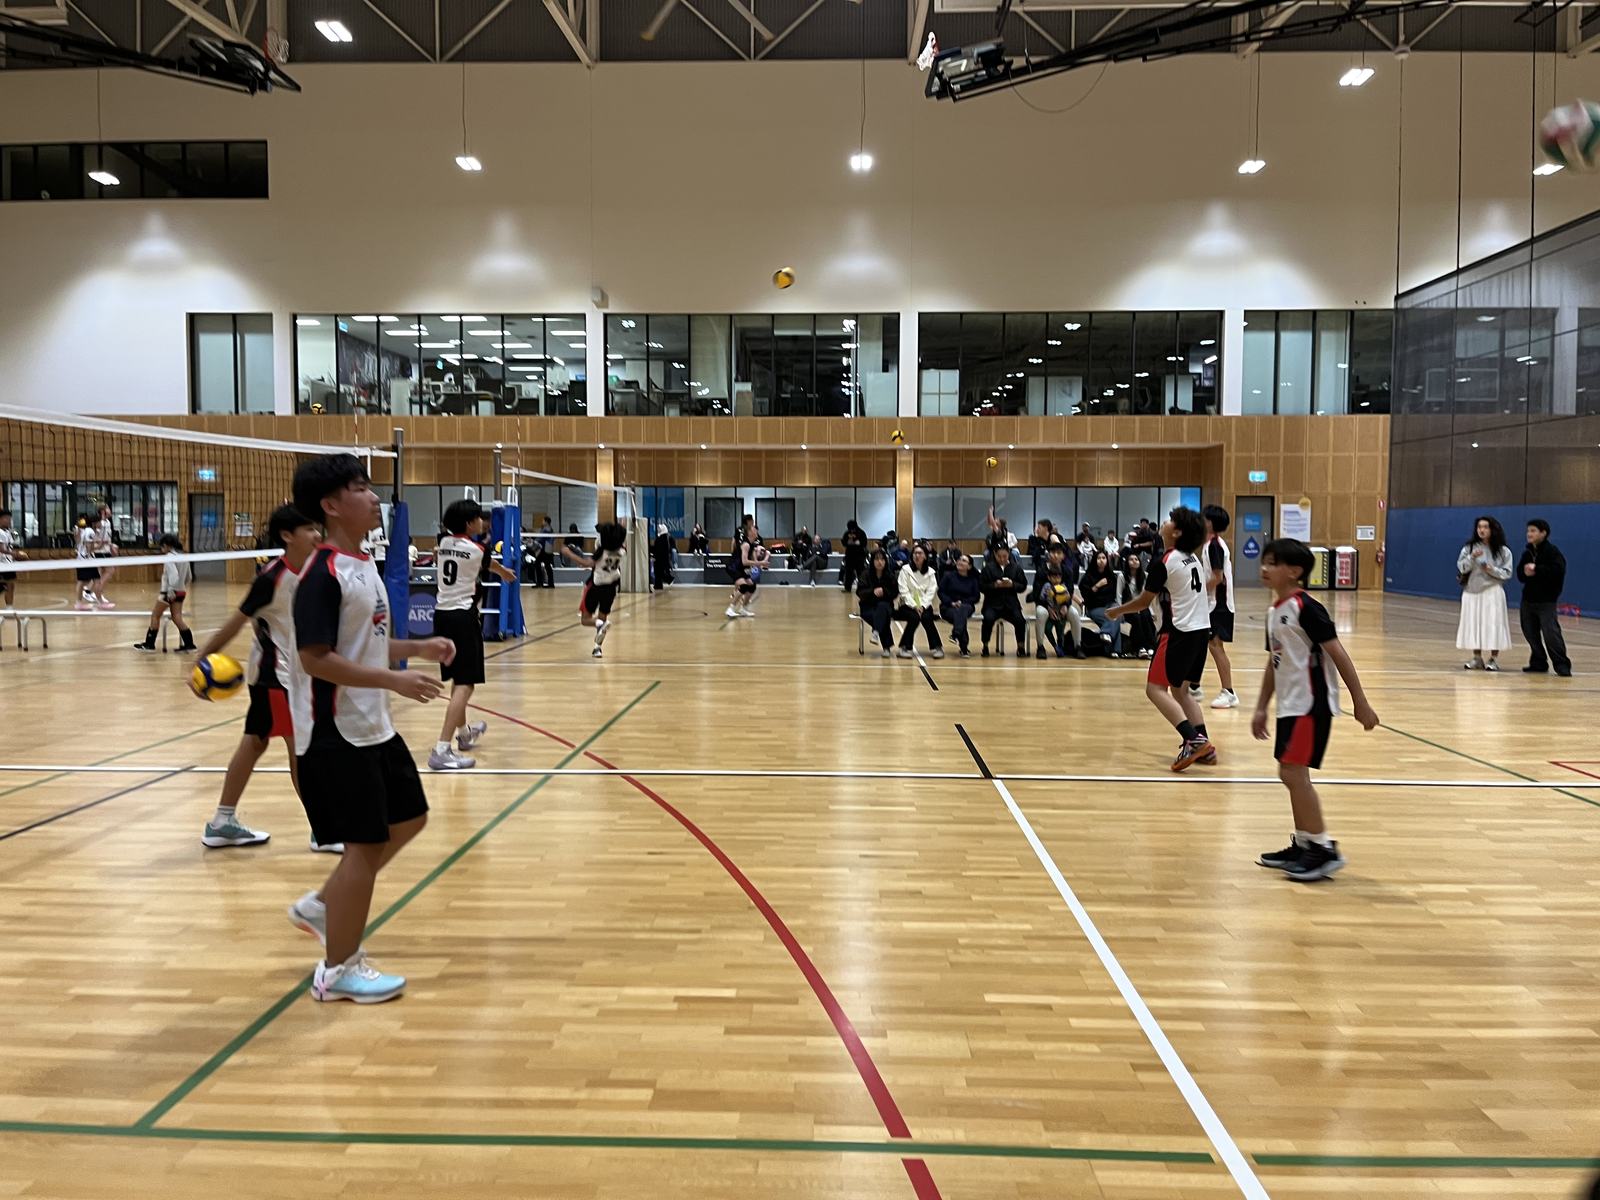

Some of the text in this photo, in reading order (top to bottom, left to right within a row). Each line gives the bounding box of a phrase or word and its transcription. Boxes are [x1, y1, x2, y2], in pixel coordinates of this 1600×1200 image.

[443, 559, 458, 586] 9
[1191, 567, 1202, 593] 4
[408, 609, 435, 621] ARC
